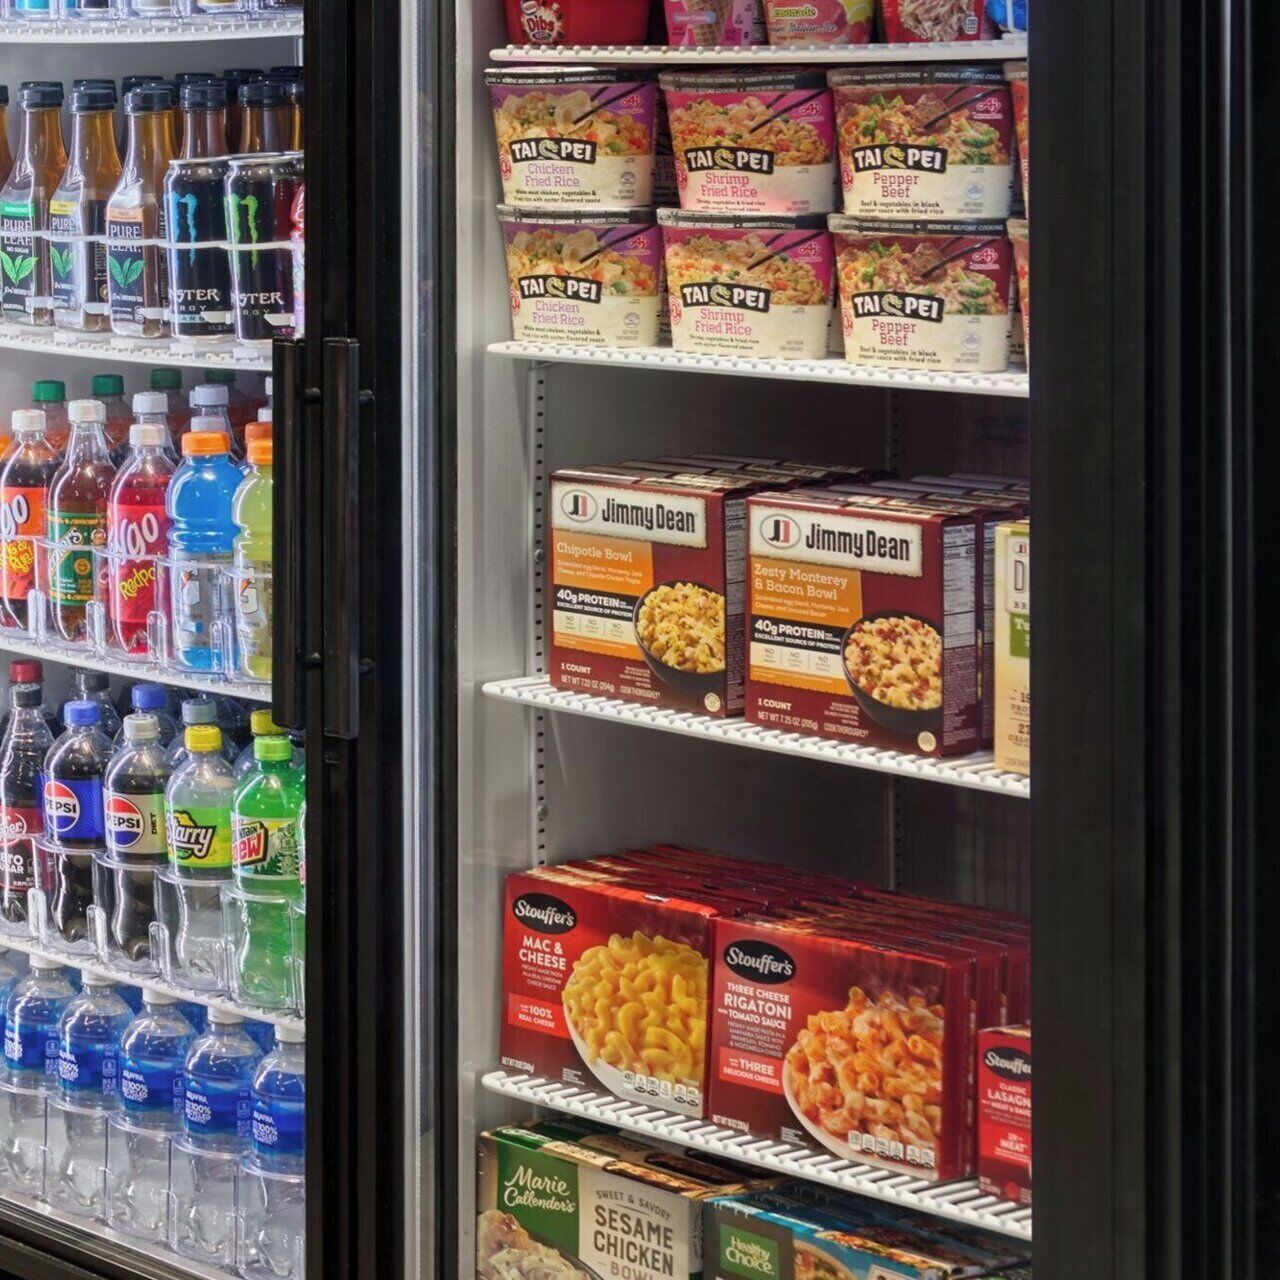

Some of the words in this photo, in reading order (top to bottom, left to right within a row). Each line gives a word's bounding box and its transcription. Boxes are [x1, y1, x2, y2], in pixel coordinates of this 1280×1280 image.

[528, 17, 555, 33] Dibs
[512, 142, 537, 160] TAI
[560, 142, 592, 160] PEI
[688, 150, 713, 169] TAI
[737, 152, 769, 171] PEI
[854, 150, 881, 168] TAI
[907, 150, 941, 168] PEI
[528, 164, 574, 176] Chicken
[706, 172, 749, 187] Shrimp
[873, 172, 919, 187] Pepper
[524, 175, 551, 187] Fried
[554, 176, 580, 188] Rice
[701, 185, 728, 197] Fried
[731, 186, 758, 198] Rice
[881, 185, 910, 198] Beef
[4, 219, 31, 231] PURE
[110, 225, 141, 238] PURE
[602, 498, 653, 530] Jimmy
[656, 504, 695, 533] Dean
[806, 523, 863, 558] Jimmy
[866, 530, 910, 561] Dean
[557, 542, 602, 559] Chipotle
[605, 549, 633, 562] Bowl
[755, 564, 788, 581] Zesty
[790, 569, 848, 589] Monterey
[557, 589, 577, 604] 40g
[579, 593, 619, 608] PROTEIN
[755, 579, 762, 589] &
[767, 581, 804, 596] Bacon
[807, 585, 838, 600] Bowl
[755, 620, 778, 635] 40g
[779, 625, 824, 639] PROTEIN
[47, 797, 77, 814] PEPSI
[515, 900, 574, 927] Stouffer's
[523, 935, 550, 950] MAC
[554, 942, 563, 954] &
[519, 950, 566, 970] CHEESE
[727, 947, 793, 975] Stouffer's
[727, 982, 754, 996] THREE
[756, 989, 789, 1003] CHEESE
[724, 993, 792, 1019] RIGATONI
[739, 1059, 774, 1076] THREE
[505, 1166, 570, 1196] Marie
[504, 1187, 575, 1213] Callender's
[594, 1205, 674, 1250] SESAME
[593, 1230, 674, 1276] CHICKEN
[731, 1236, 770, 1259] Healthy
